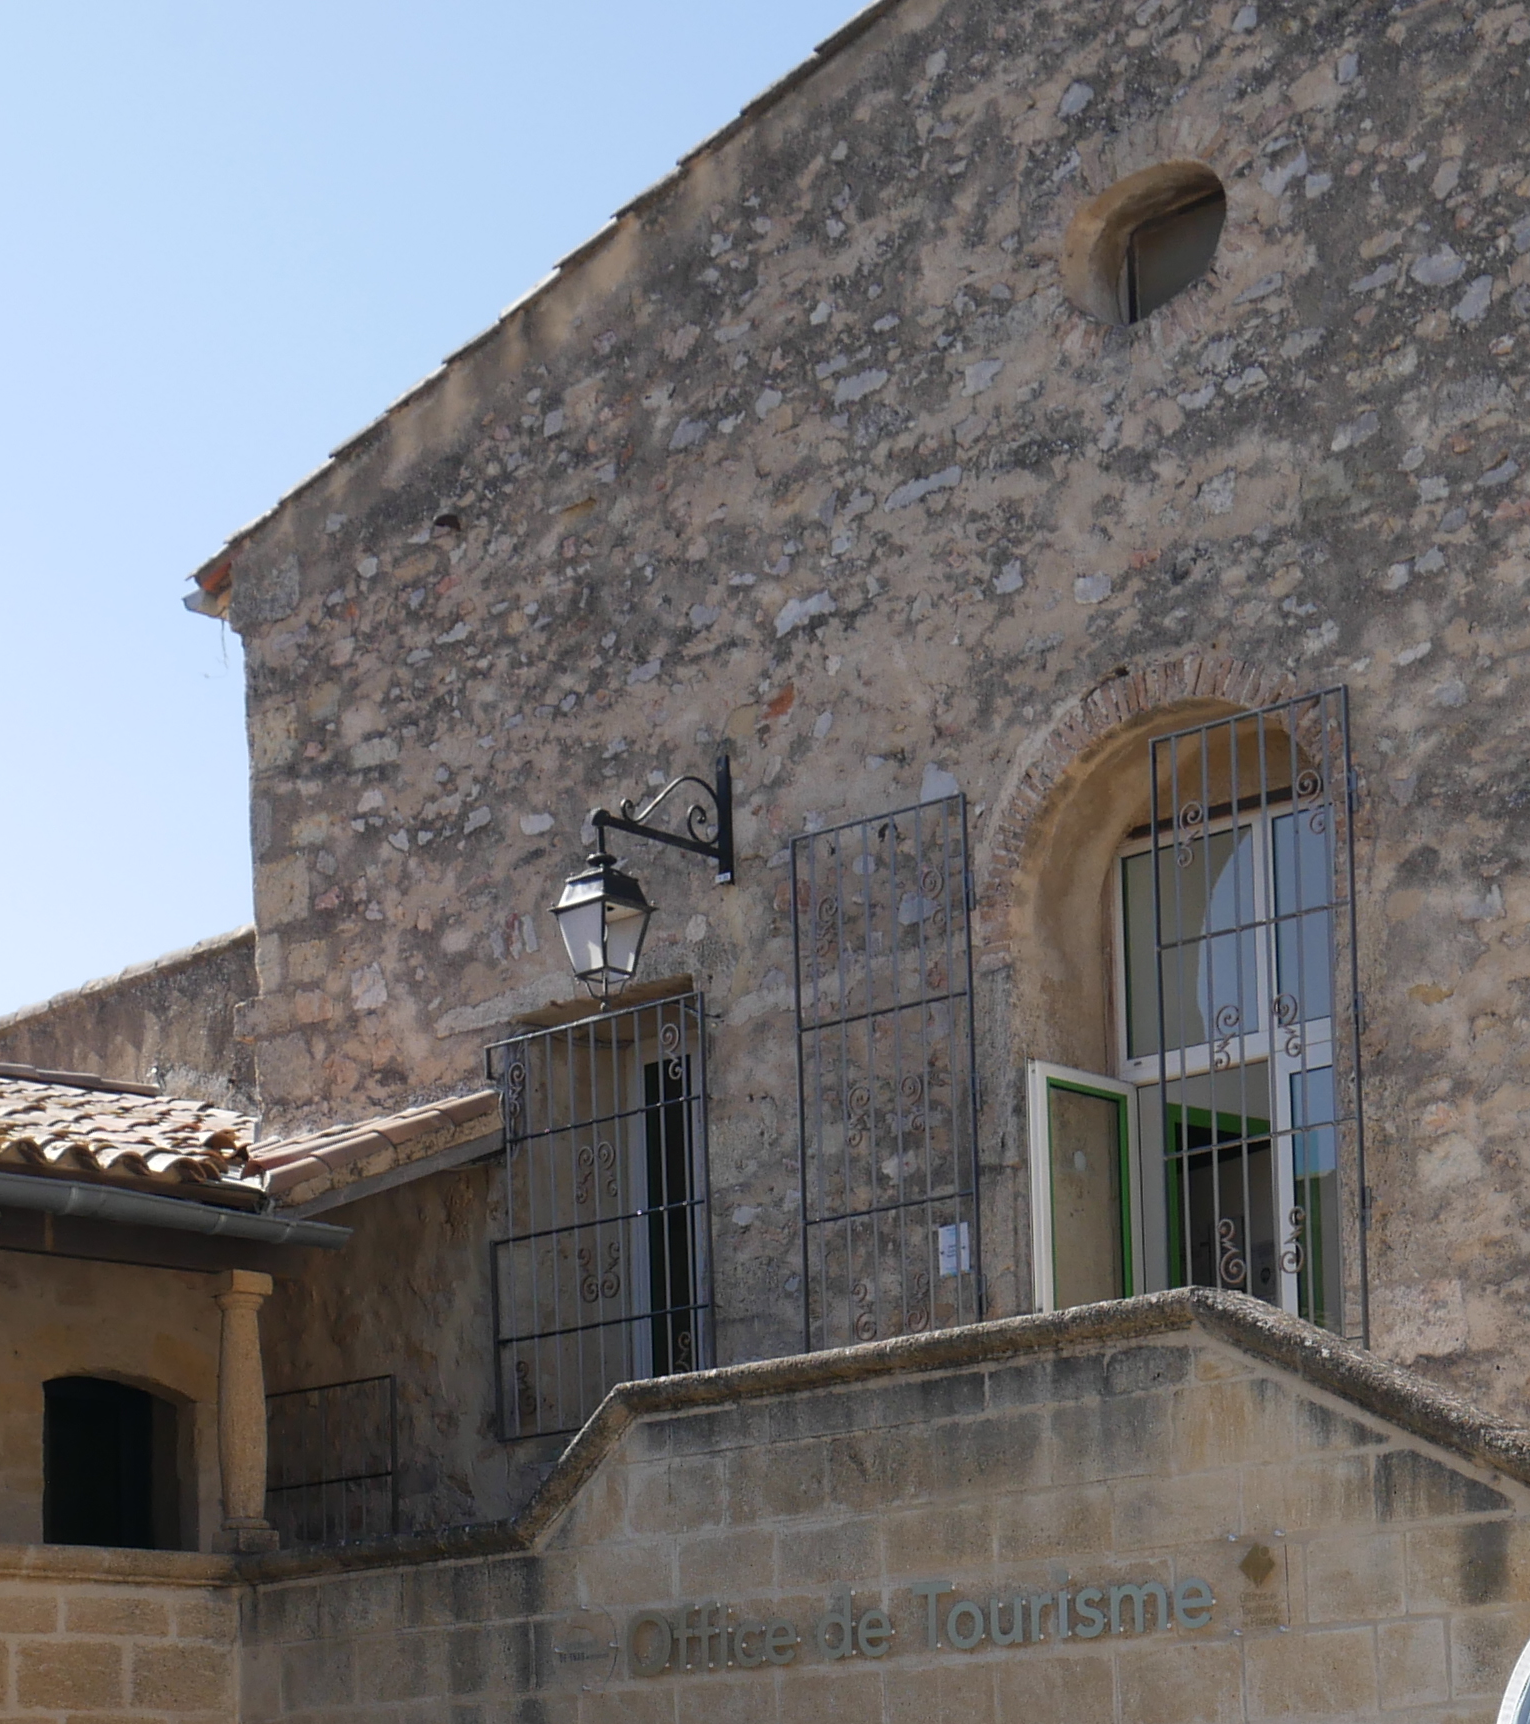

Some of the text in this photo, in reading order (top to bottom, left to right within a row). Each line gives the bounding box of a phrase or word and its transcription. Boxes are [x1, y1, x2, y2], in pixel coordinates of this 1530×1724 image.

[626, 1565, 1215, 1678] Office de Tourisme
